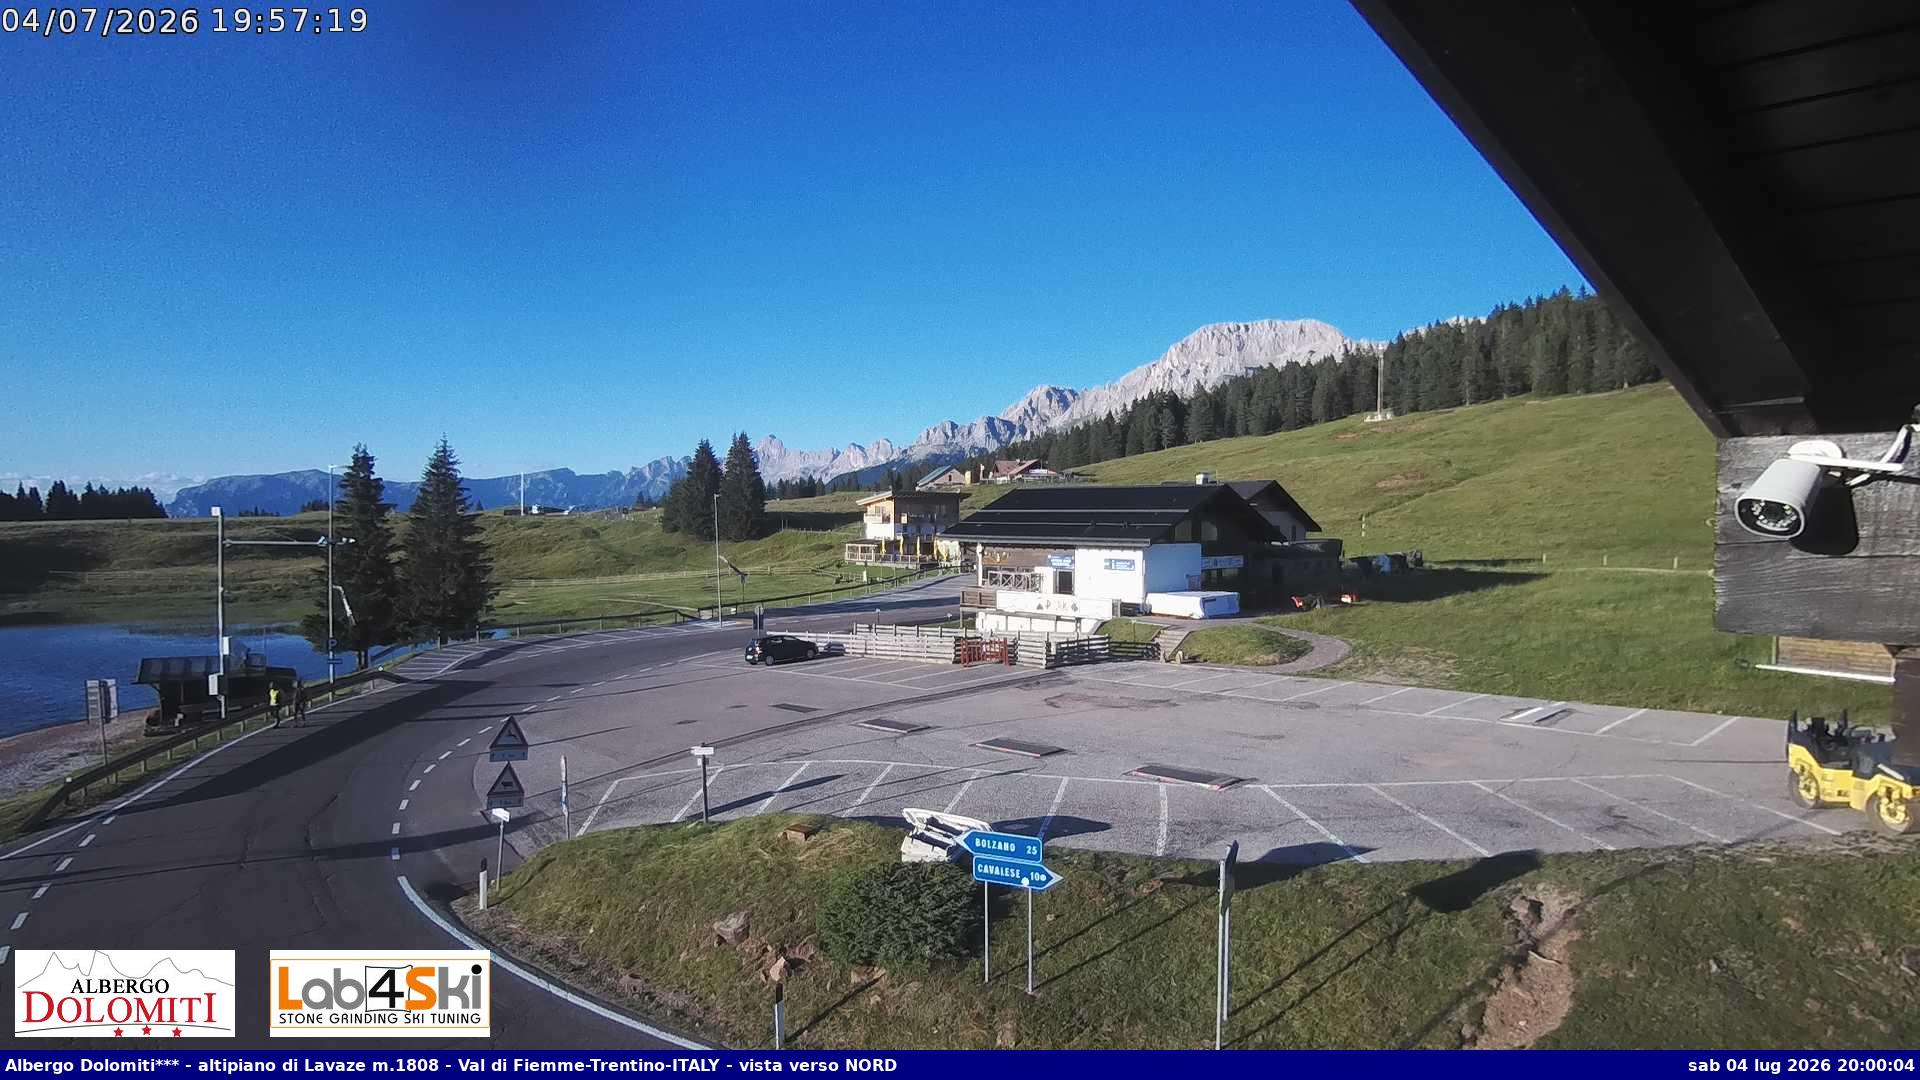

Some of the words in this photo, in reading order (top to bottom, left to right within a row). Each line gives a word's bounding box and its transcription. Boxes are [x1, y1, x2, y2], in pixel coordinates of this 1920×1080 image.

[974, 837, 1016, 852] BOLZANO
[1026, 845, 1038, 855] 25
[977, 863, 1021, 879] CAVALESE
